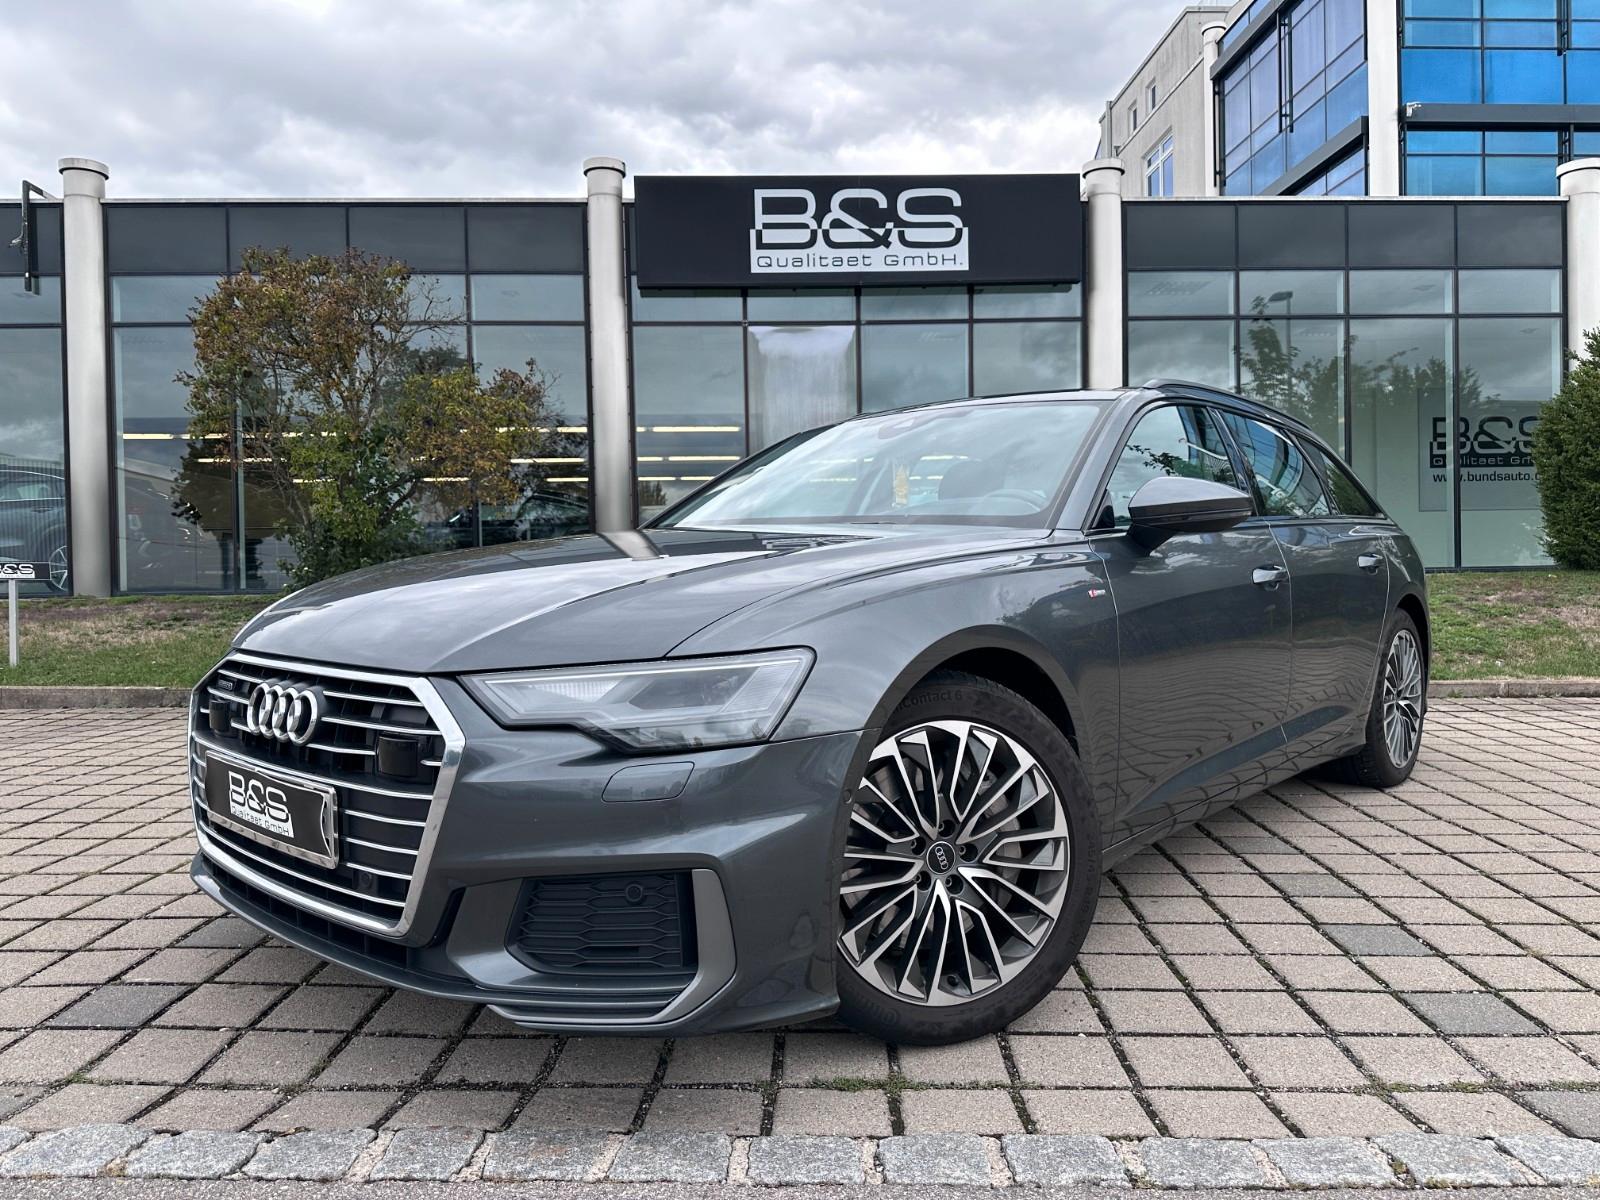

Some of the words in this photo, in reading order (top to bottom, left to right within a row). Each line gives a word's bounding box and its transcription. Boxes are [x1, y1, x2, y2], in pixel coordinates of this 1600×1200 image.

[754, 187, 964, 250] B&S
[756, 252, 873, 268] Qualitaet
[883, 251, 964, 266] GmbH.
[0, 563, 34, 575] &S
[228, 770, 290, 823] B&S
